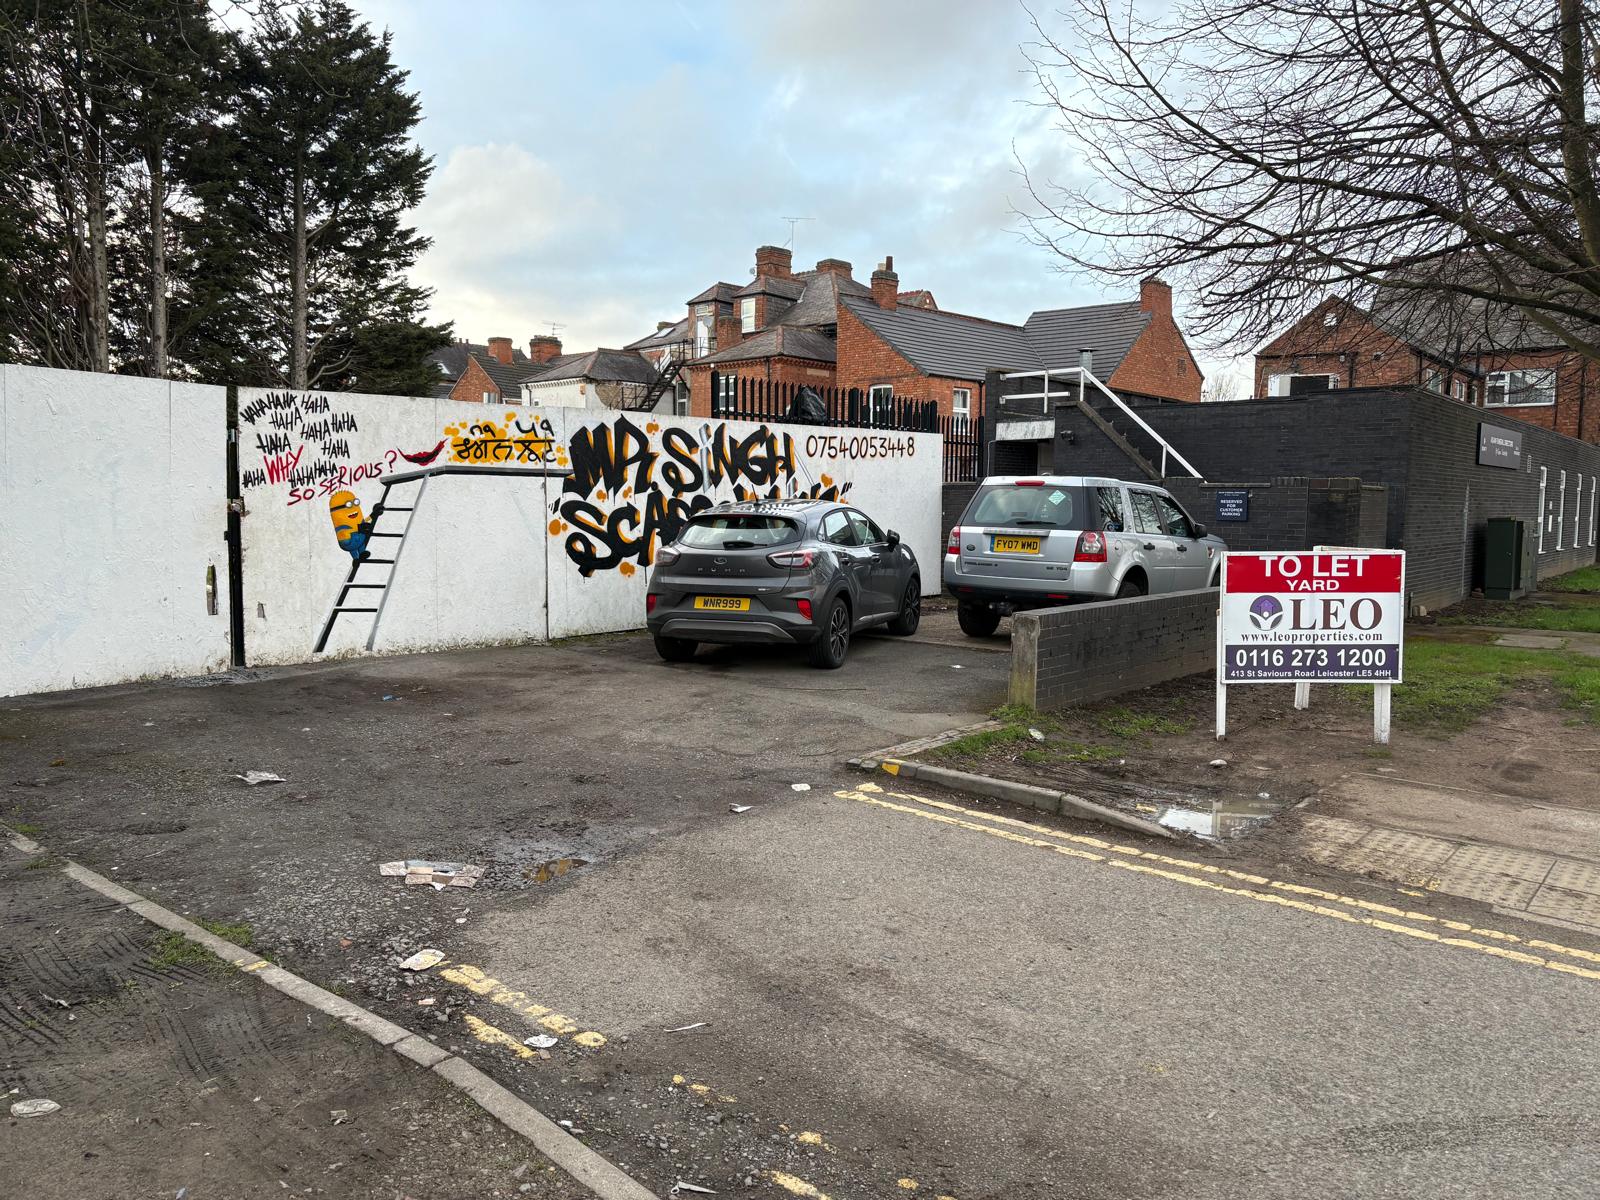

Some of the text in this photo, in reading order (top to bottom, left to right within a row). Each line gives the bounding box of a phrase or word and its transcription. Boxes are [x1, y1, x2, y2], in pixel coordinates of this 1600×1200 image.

[301, 394, 330, 414] HAHA
[269, 406, 303, 432] HAHA
[300, 411, 358, 443] HAHA HAHA
[256, 433, 292, 455] HAHA
[321, 438, 350, 459] HAHA
[806, 434, 915, 460] 07540053448
[264, 444, 304, 485] WHY
[242, 468, 267, 488] HAHA
[287, 488, 315, 506] SO
[996, 539, 1038, 551] FY07 WMD
[1259, 555, 1370, 577] TO LET
[1286, 579, 1340, 591] YARD
[702, 597, 742, 609] WNR999
[1289, 598, 1383, 630] LEO
[1241, 631, 1383, 643] www.leoproperties.com
[1235, 649, 1387, 667] 0116 273 1200
[1257, 669, 1292, 678] Saviours
[1294, 669, 1316, 677] Road
[1317, 669, 1355, 677] Leicester
[1356, 669, 1373, 677] LE5
